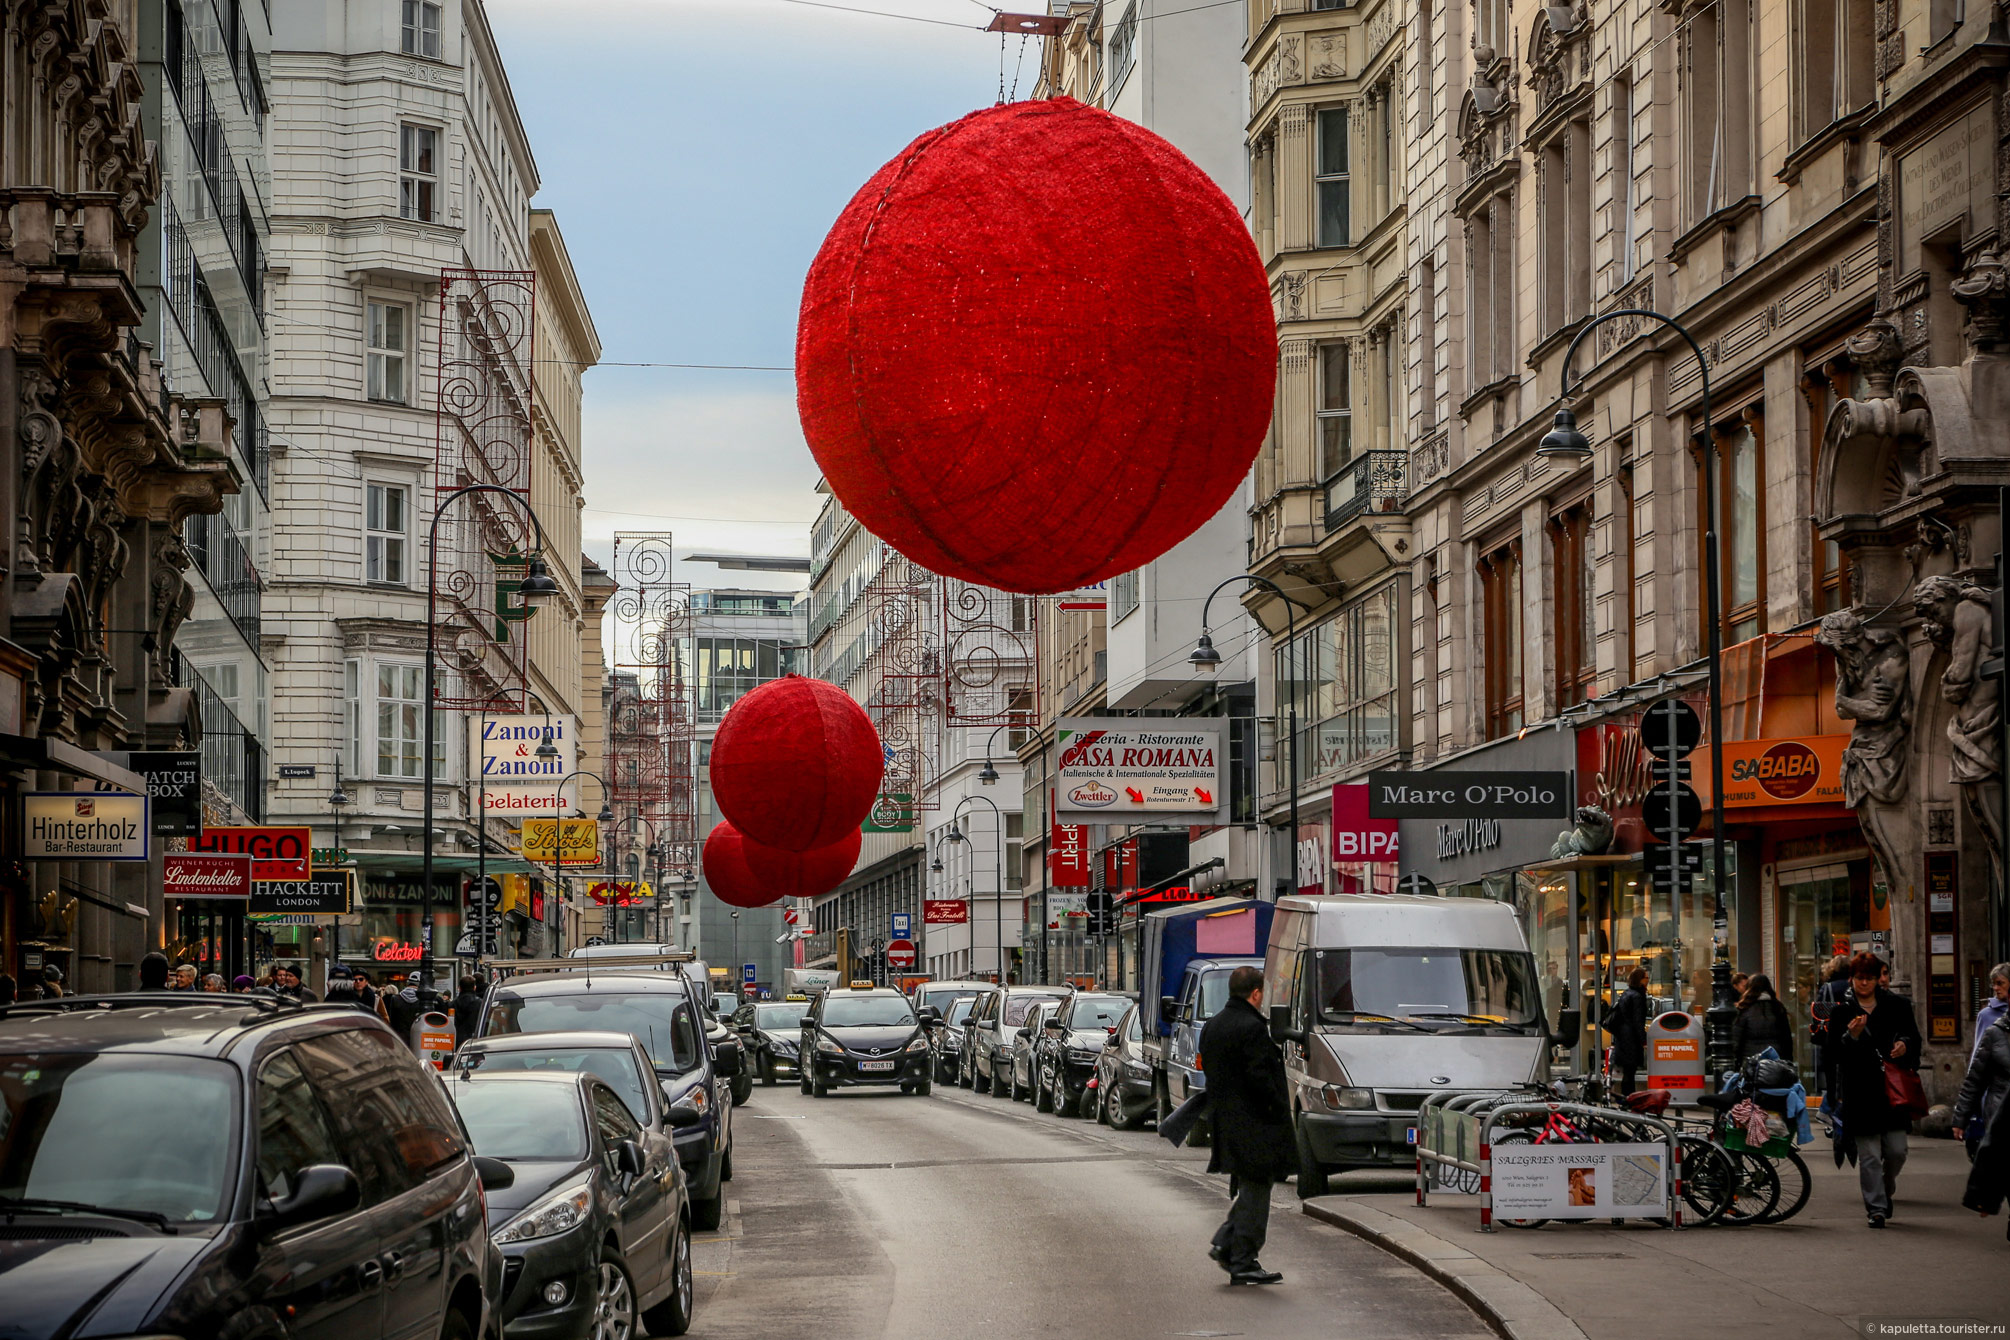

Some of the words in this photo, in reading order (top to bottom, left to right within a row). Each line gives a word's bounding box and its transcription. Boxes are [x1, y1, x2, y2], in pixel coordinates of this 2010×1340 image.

[483, 721, 563, 741] Zanoni
[1074, 734, 1126, 745] Pizzeria
[1137, 733, 1204, 745] Ristorante
[515, 743, 529, 757] &
[1061, 747, 1114, 767] CASA
[1120, 747, 1215, 768] ROMANA
[483, 755, 563, 775] Zanoni
[1731, 754, 1816, 782] SABABA
[1063, 769, 1105, 778] Italienische
[1107, 770, 1114, 778] &
[1116, 769, 1167, 778] Internationale
[1168, 769, 1215, 780] Spezialitäten
[147, 784, 184, 798] BOX
[1074, 790, 1113, 802] Zwettler
[1153, 786, 1188, 796] Eingang
[1382, 785, 1456, 804] Marc
[1464, 785, 1555, 804] O'Polo
[1723, 792, 1756, 801] HUMUS
[478, 793, 568, 809] Gelateria
[32, 817, 137, 840] Hinterholz
[525, 824, 594, 849] Ströck
[1340, 832, 1398, 855] BIPA
[1436, 823, 1462, 859] Marc
[45, 841, 123, 853] Bar-Restaurant
[195, 835, 303, 864] HUGO
[206, 858, 235, 867] KÜCHE
[163, 866, 243, 887] Lindenkeller
[254, 881, 343, 896] HACKETT
[276, 898, 320, 906] LONDON
[895, 919, 906, 927] Taxi
[375, 941, 423, 961] Gelateri
[1498, 1155, 1555, 1167] SALZGRIES
[1557, 1155, 1607, 1166] MASSAGE
